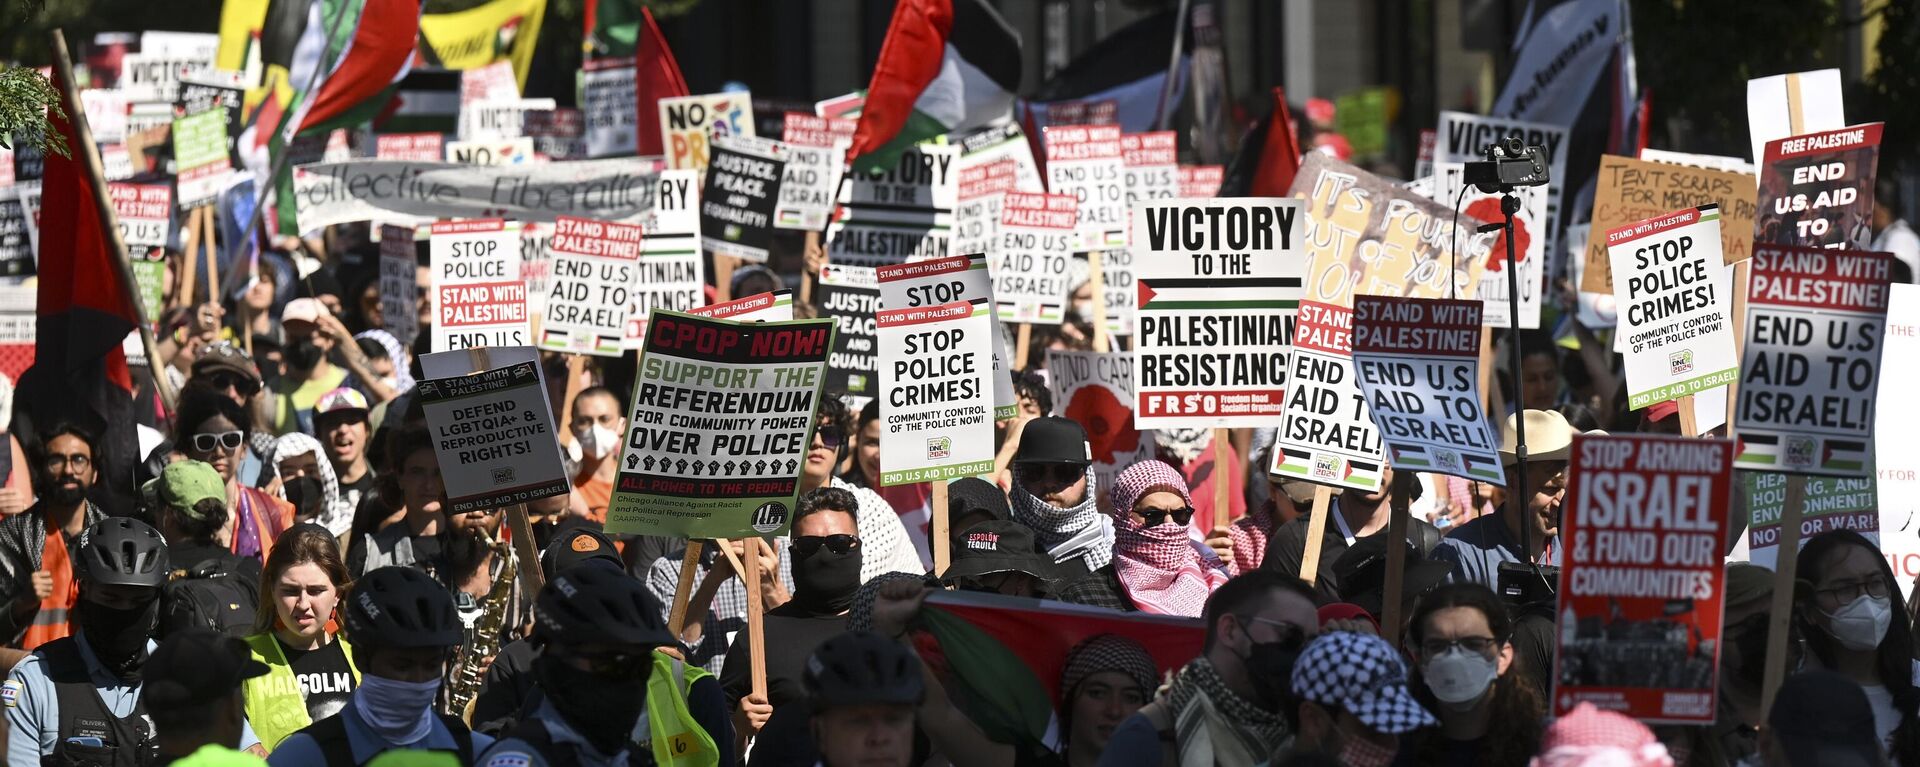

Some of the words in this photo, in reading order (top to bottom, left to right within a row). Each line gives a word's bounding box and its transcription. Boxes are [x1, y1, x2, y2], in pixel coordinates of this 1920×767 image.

[667, 103, 705, 131] NO
[1781, 139, 1806, 155] FREE
[1806, 130, 1865, 151] PALESTINE
[1055, 167, 1086, 182] END
[1605, 165, 1664, 188] TENT
[1668, 173, 1733, 194] SCRAPS
[1793, 162, 1846, 186] END
[140, 188, 169, 202] WITH
[1621, 188, 1658, 206] FOR
[1775, 194, 1810, 215] U.S.
[1812, 187, 1857, 210] AID
[117, 201, 168, 218] LESTINE!
[556, 219, 602, 235] STAND
[606, 225, 641, 242] WITH
[1146, 206, 1297, 251] VICTORY
[1610, 229, 1633, 242] STAND
[1635, 224, 1653, 236] WITH
[1654, 213, 1693, 230] PALESTINE!
[1797, 218, 1830, 239] TO
[452, 240, 498, 258] STOP
[553, 234, 639, 259] PALESTINE!
[1004, 233, 1036, 249] END
[1636, 236, 1693, 270] STOP
[444, 260, 505, 279] POLICE
[554, 258, 592, 279] END
[601, 264, 630, 283] U.S
[880, 268, 903, 279] STAND
[905, 266, 924, 276] WITH
[924, 260, 963, 274] PALESTINE!
[1002, 254, 1033, 272] AID
[1043, 256, 1066, 275] TO
[1192, 254, 1213, 275] TO
[1219, 254, 1251, 275] THE
[1754, 249, 1827, 277] STAND
[1835, 255, 1889, 280] WITH
[998, 277, 1063, 296] ISRAEL!
[1629, 259, 1707, 300] POLICE
[1751, 276, 1887, 308] PALESTINE!
[442, 286, 489, 304] STAND
[492, 285, 525, 302] WITH
[550, 280, 589, 302] AID
[599, 286, 627, 307] TO
[906, 281, 965, 307] STOP
[1628, 284, 1717, 327] CRIMES!
[443, 303, 525, 324] PALESTINE!
[547, 304, 624, 329] ISRAEL!
[713, 305, 731, 317] WITH
[732, 297, 769, 313] PALESTINE!
[881, 313, 904, 324] STAND
[906, 311, 926, 321] WITH
[927, 305, 967, 318] PALESTINE!
[1300, 304, 1352, 330] STAND
[1355, 300, 1423, 323] STAND
[1431, 305, 1479, 326] WITH
[653, 320, 738, 356] CPOP
[751, 329, 827, 357] NOW!
[1140, 315, 1297, 347] PALESTINIAN
[1355, 326, 1478, 351] PALESTINE!
[1629, 323, 1680, 345] COMMUNITY
[1683, 312, 1724, 331] CONTROL
[1633, 345, 1644, 354] OF
[1646, 338, 1663, 351] THE
[1666, 329, 1696, 345] POLICE
[1698, 321, 1722, 335] NOW!
[1752, 314, 1814, 347] END
[1827, 320, 1876, 352] U.S
[847, 338, 872, 352] AND
[904, 328, 965, 356] STOP
[445, 374, 480, 390] STAND
[482, 369, 510, 384] WITH
[644, 358, 763, 390] SUPPORT
[774, 366, 818, 388] THE
[894, 352, 975, 382] POLICE
[1296, 356, 1344, 385] END
[1360, 361, 1416, 388] END
[1426, 364, 1470, 393] U.S
[1673, 363, 1692, 373] 2024
[1745, 351, 1810, 388] AID
[1826, 355, 1873, 393] TO
[450, 378, 509, 398] PALESTINE!
[638, 382, 813, 415] REFERENDUM
[890, 377, 981, 408] CRIMES!
[1221, 394, 1250, 404] Freedom
[1251, 394, 1269, 403] Road
[1288, 384, 1339, 416] AID
[1632, 395, 1650, 408] END
[1669, 385, 1686, 398] AID
[1689, 380, 1701, 391] TO
[1703, 369, 1738, 387] ISRAEL!
[452, 400, 517, 421] DEFEND
[888, 411, 941, 425] COMMUNITY
[944, 405, 986, 419] CONTROL
[1375, 389, 1424, 415] AID
[1433, 395, 1478, 423] TO
[1742, 390, 1868, 431] ISRAEL!
[439, 415, 518, 438] LGBTQIA+
[523, 410, 537, 422] &
[635, 410, 664, 425] FOR
[669, 414, 756, 431] COMMUNITY
[760, 416, 807, 430] POWER
[890, 424, 902, 434] OF
[906, 421, 922, 432] THE
[925, 418, 957, 430] POLICE
[959, 415, 984, 427] NOW!
[1378, 415, 1490, 450] ISRAEL!
[440, 423, 546, 451] REPRODUCTIVE
[629, 427, 700, 456] OVER
[711, 432, 805, 456] POLICE
[1285, 414, 1381, 456] ISRAEL!
[458, 440, 532, 464] RIGHTS!
[929, 450, 949, 459] 2024
[1580, 440, 1633, 470] STOP
[1637, 440, 1723, 473] ARMING
[884, 472, 903, 484] END
[924, 468, 940, 479] AID
[943, 466, 956, 476] TO
[958, 462, 993, 475] ISRAEL!
[1315, 468, 1337, 478] 2024
[1317, 462, 1331, 470] DNC
[1889, 470, 1915, 481] FOR
[621, 478, 646, 490] ALL
[651, 480, 695, 495] POWER
[700, 483, 715, 495] TO
[720, 483, 745, 495] THE
[748, 480, 794, 494] PEOPLE
[1835, 478, 1870, 492] AND
[454, 501, 473, 513] END
[495, 495, 511, 506] AID
[514, 492, 528, 502] TO
[531, 484, 567, 499] ISRAEL!
[617, 495, 651, 506] Chicago
[652, 498, 685, 508] Alliance
[686, 501, 717, 511] Against
[1575, 471, 1719, 531] ISRAEL
[615, 505, 630, 513] and
[632, 506, 666, 517] Political
[666, 509, 712, 519] Repression
[1752, 527, 1781, 546] NOT
[1829, 514, 1873, 530] WAR!
[967, 541, 997, 551] TEQUILA
[1572, 530, 1591, 563] &
[1594, 530, 1658, 566] FUND
[1662, 533, 1718, 568] OUR
[1570, 566, 1714, 600] COMMUNITIES
[256, 671, 351, 700] MALCOLM
